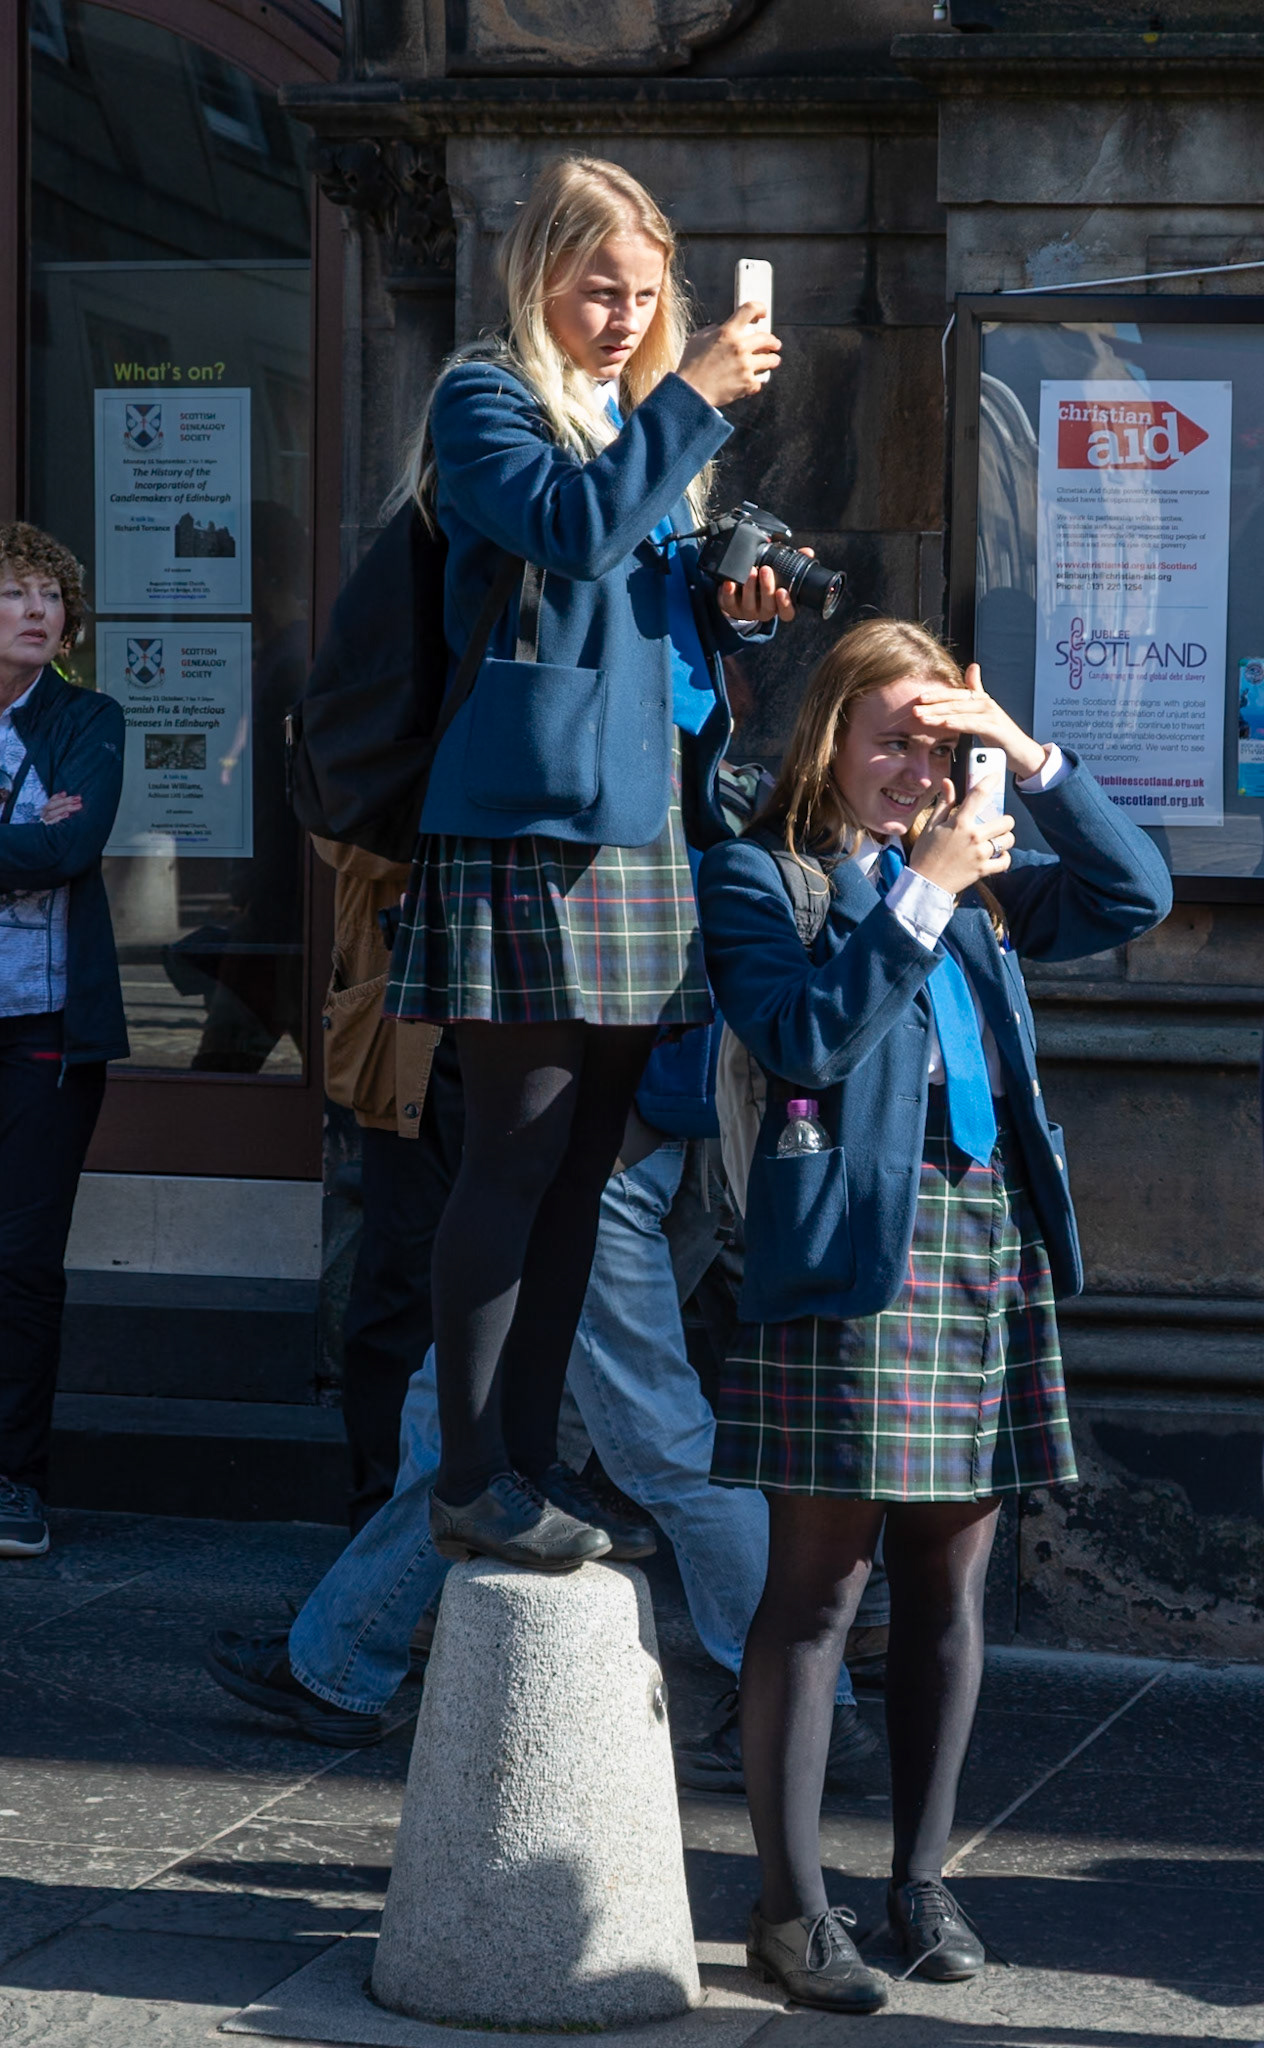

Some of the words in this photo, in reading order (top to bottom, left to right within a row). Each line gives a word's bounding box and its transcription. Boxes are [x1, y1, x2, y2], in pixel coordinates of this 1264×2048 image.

[114, 362, 182, 381] What's
[188, 362, 226, 381] on?
[180, 412, 216, 420] SCOTTISH
[1059, 404, 1152, 425] christian
[180, 423, 226, 431] GENEALOGY
[180, 434, 211, 442] SOCIETY
[1087, 411, 1185, 467] aid
[133, 468, 149, 477] The
[151, 468, 182, 477] History
[184, 468, 194, 477] of
[196, 468, 211, 477] the
[135, 481, 195, 491] Incorporation
[197, 481, 207, 491] of
[110, 494, 172, 503] Candlemakers
[174, 494, 184, 503] of
[186, 494, 231, 503] Edinburgh
[1056, 582, 1084, 590] Phone:
[1124, 582, 1142, 590] 1254
[1091, 630, 1130, 640] JUBILEE
[181, 648, 217, 656] SCOTTISH
[1055, 641, 1207, 668] SCOTLAND
[181, 659, 227, 667] GENEALOGY
[1150, 672, 1168, 682] global
[1169, 672, 1184, 681] debt
[1185, 673, 1206, 683] slavery
[1052, 698, 1080, 706] Jubilee
[1082, 698, 1116, 706] Scotland
[1182, 700, 1206, 708] global
[157, 705, 170, 715] Flu
[172, 705, 180, 715] &
[182, 705, 225, 715] Infectious
[1052, 710, 1084, 719] partners
[1085, 710, 1096, 718] for
[1097, 710, 1109, 718] the
[1157, 710, 1166, 718] of
[1166, 711, 1189, 720] unjust
[1190, 711, 1206, 719] and
[125, 718, 162, 728] Diseases
[164, 718, 173, 728] in
[175, 718, 220, 728] Edinburgh
[1052, 720, 1091, 729] unpayable
[1092, 720, 1114, 728] debts
[1180, 722, 1205, 730] thwart
[1052, 732, 1098, 740] anti-poverty
[1098, 732, 1112, 740] and
[1156, 733, 1205, 742] development
[1104, 755, 1140, 763] economy.
